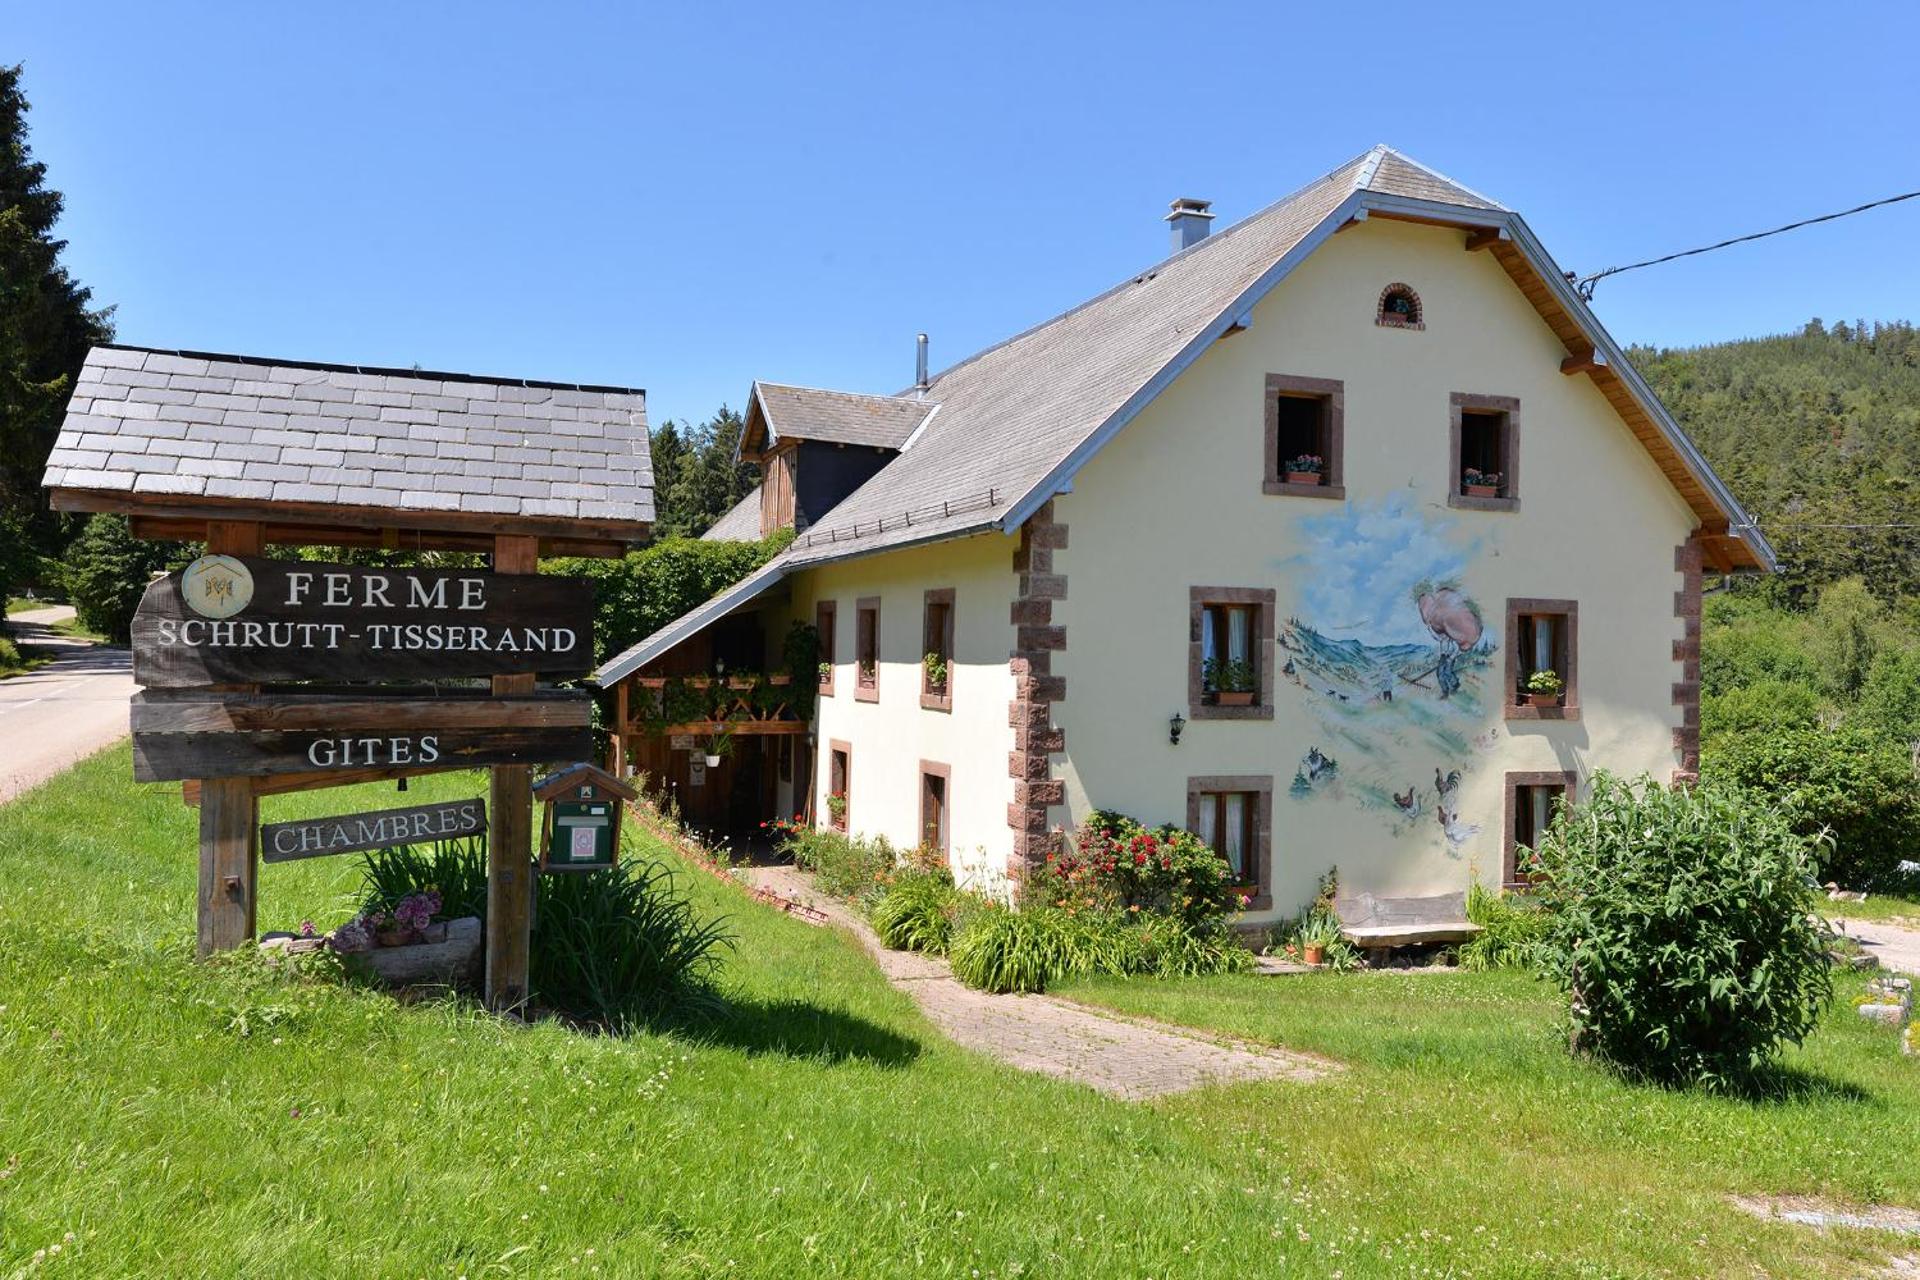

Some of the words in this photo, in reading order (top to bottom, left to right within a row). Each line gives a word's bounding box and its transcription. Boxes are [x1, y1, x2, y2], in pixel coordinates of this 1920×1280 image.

[284, 572, 488, 610] FERME
[158, 619, 577, 652] SCHRUTT-TISSERAND
[308, 735, 439, 767] GITES
[274, 804, 478, 854] CHAMBRES
